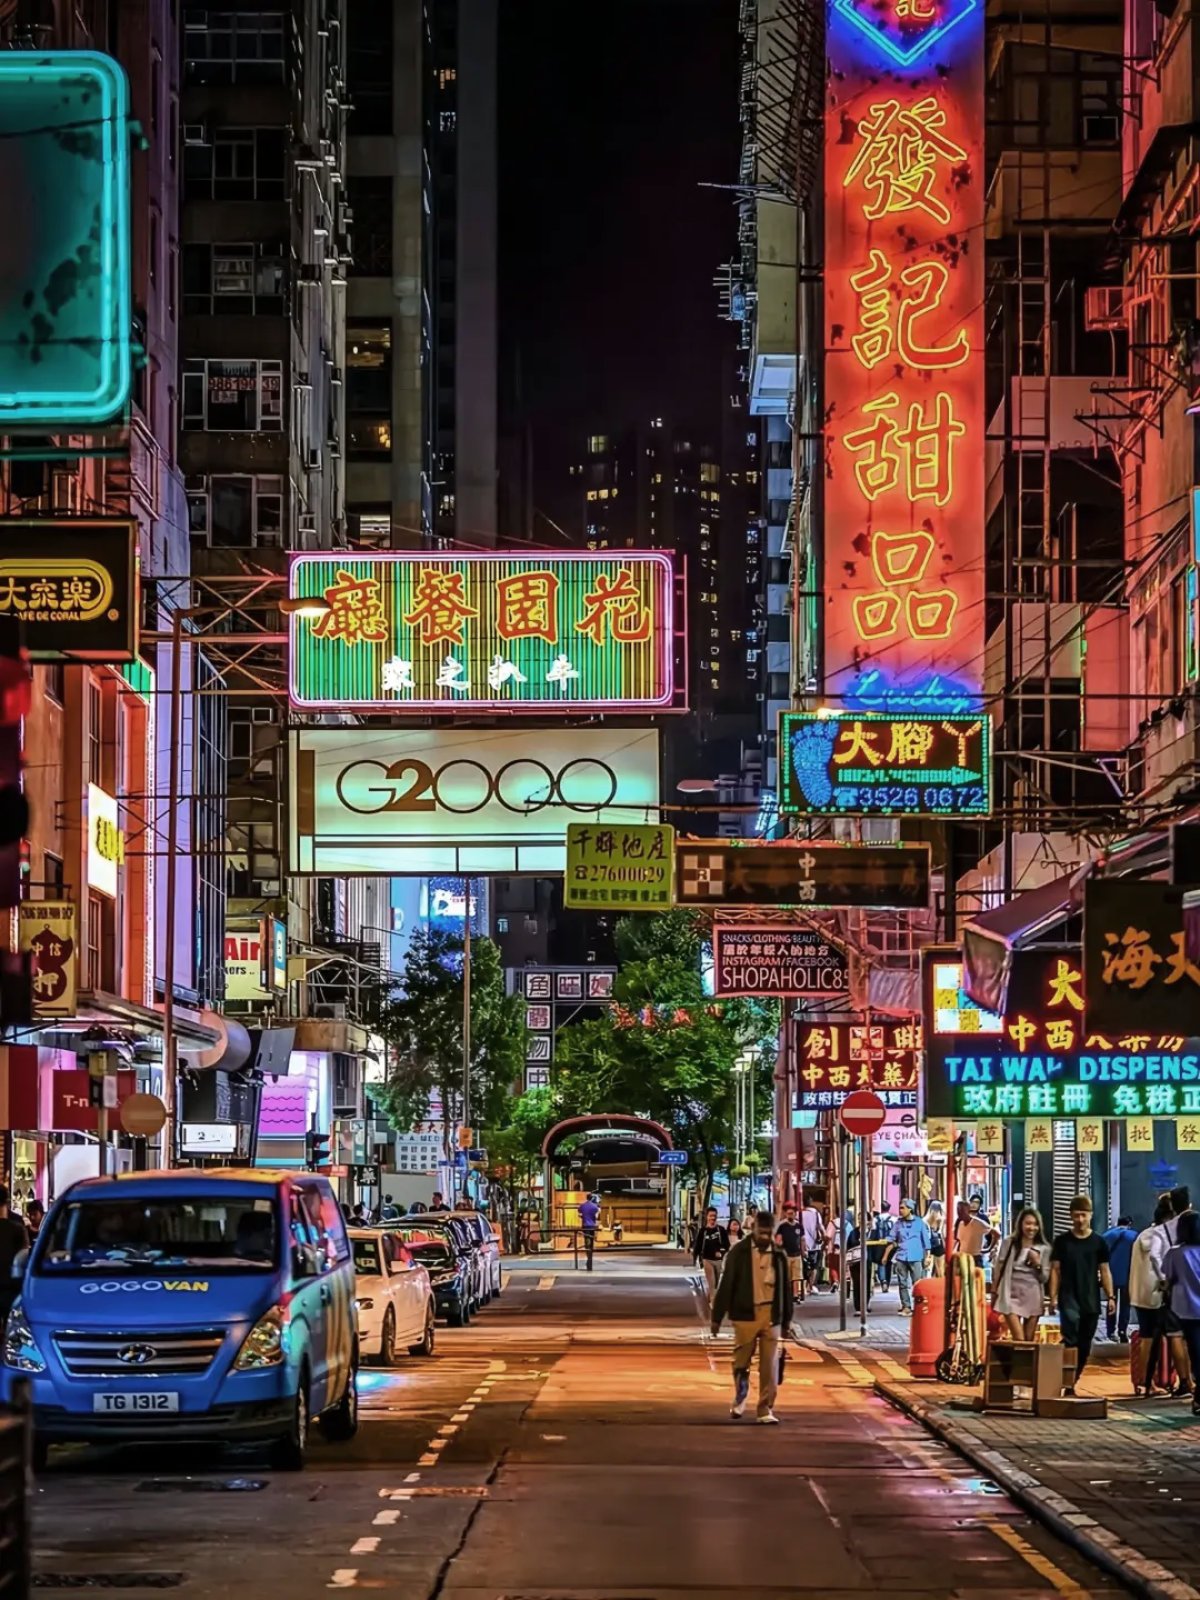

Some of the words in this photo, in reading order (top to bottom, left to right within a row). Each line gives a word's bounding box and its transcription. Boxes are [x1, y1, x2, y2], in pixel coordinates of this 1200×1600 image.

[843, 98, 969, 640] 發記甜品
[312, 570, 652, 645] 花園餐廳
[336, 758, 617, 814] G2000
[859, 787, 918, 807] 3526
[923, 787, 983, 807] 0672
[944, 1057, 993, 1082] TAI
[1079, 1056, 1200, 1081] DISPENS
[79, 1281, 209, 1294] GOGOVAN
[102, 1395, 125, 1410] TG
[133, 1395, 168, 1410] 1312
